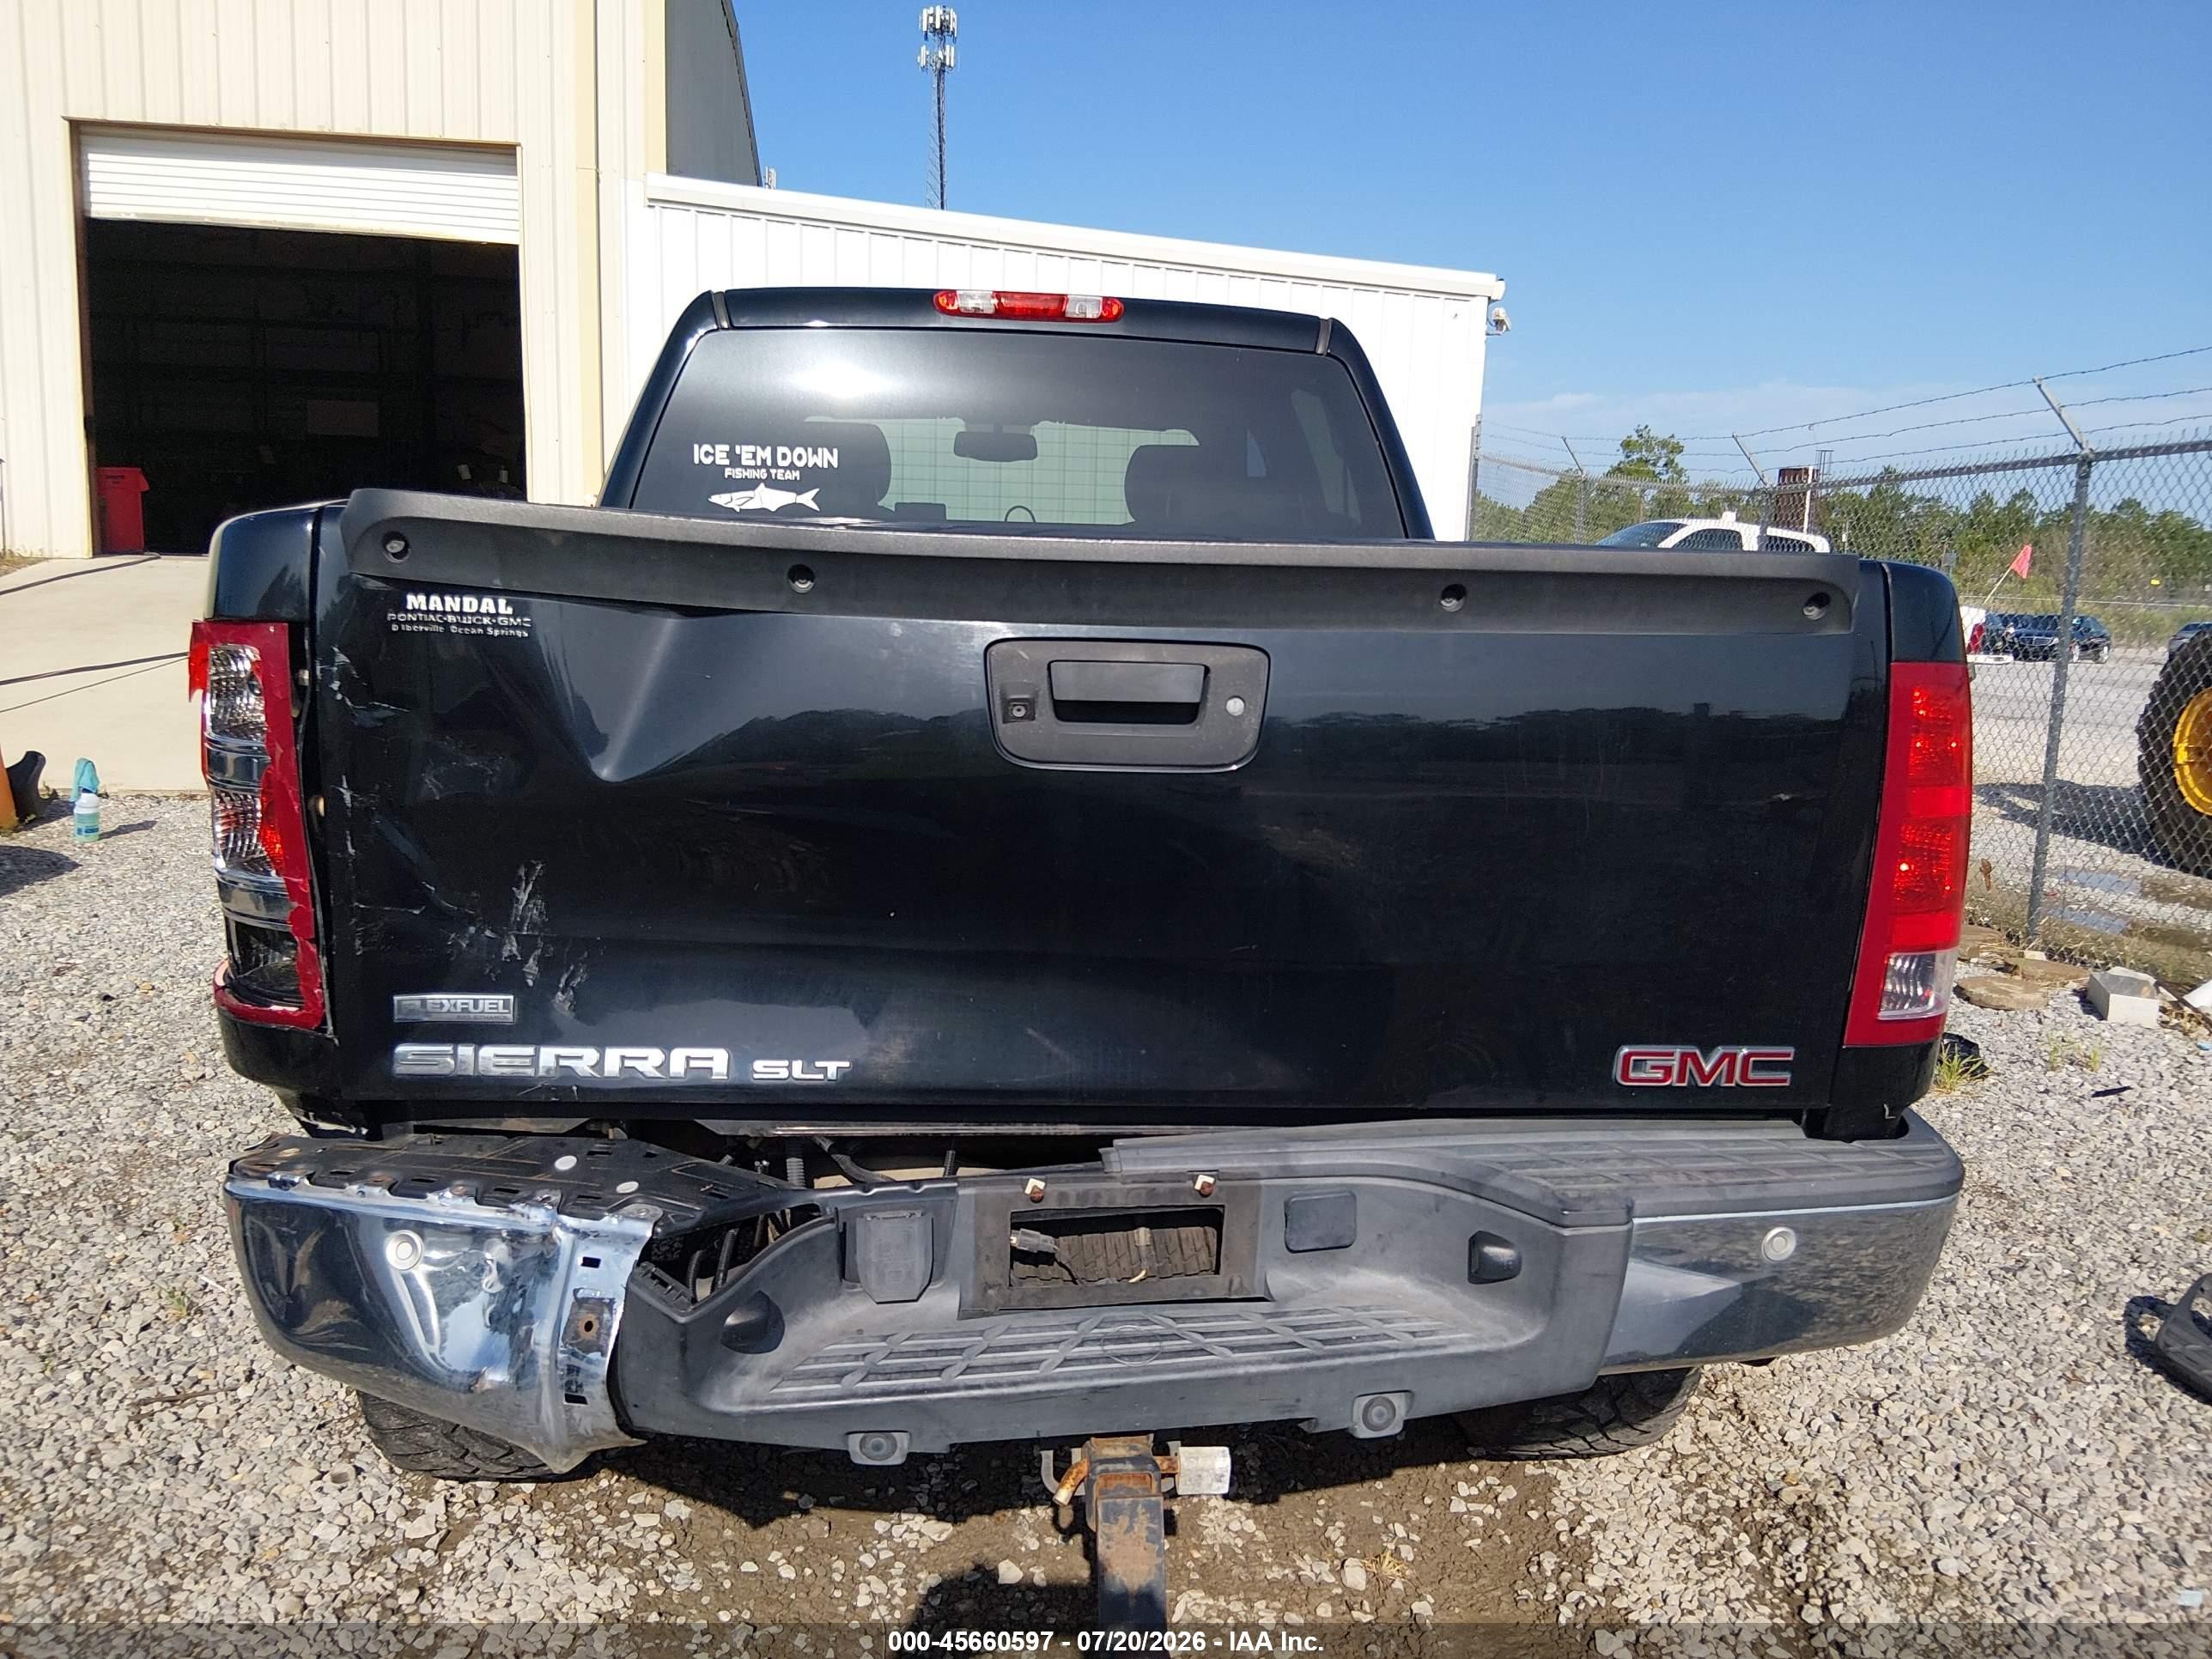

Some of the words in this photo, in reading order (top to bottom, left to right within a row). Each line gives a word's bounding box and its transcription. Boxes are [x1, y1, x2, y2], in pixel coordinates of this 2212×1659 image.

[693, 443, 730, 465] ICE
[735, 445, 772, 466] 'EM
[776, 446, 839, 469] DOWN
[724, 467, 768, 480] FISHING
[770, 468, 800, 481] TEAM
[406, 592, 514, 615] MANDAL
[449, 626, 484, 635] Ocean
[487, 627, 529, 637] Springs
[392, 1043, 730, 1080] SIERRA
[751, 1060, 852, 1081] SLT
[1613, 1044, 1795, 1087] GMC
